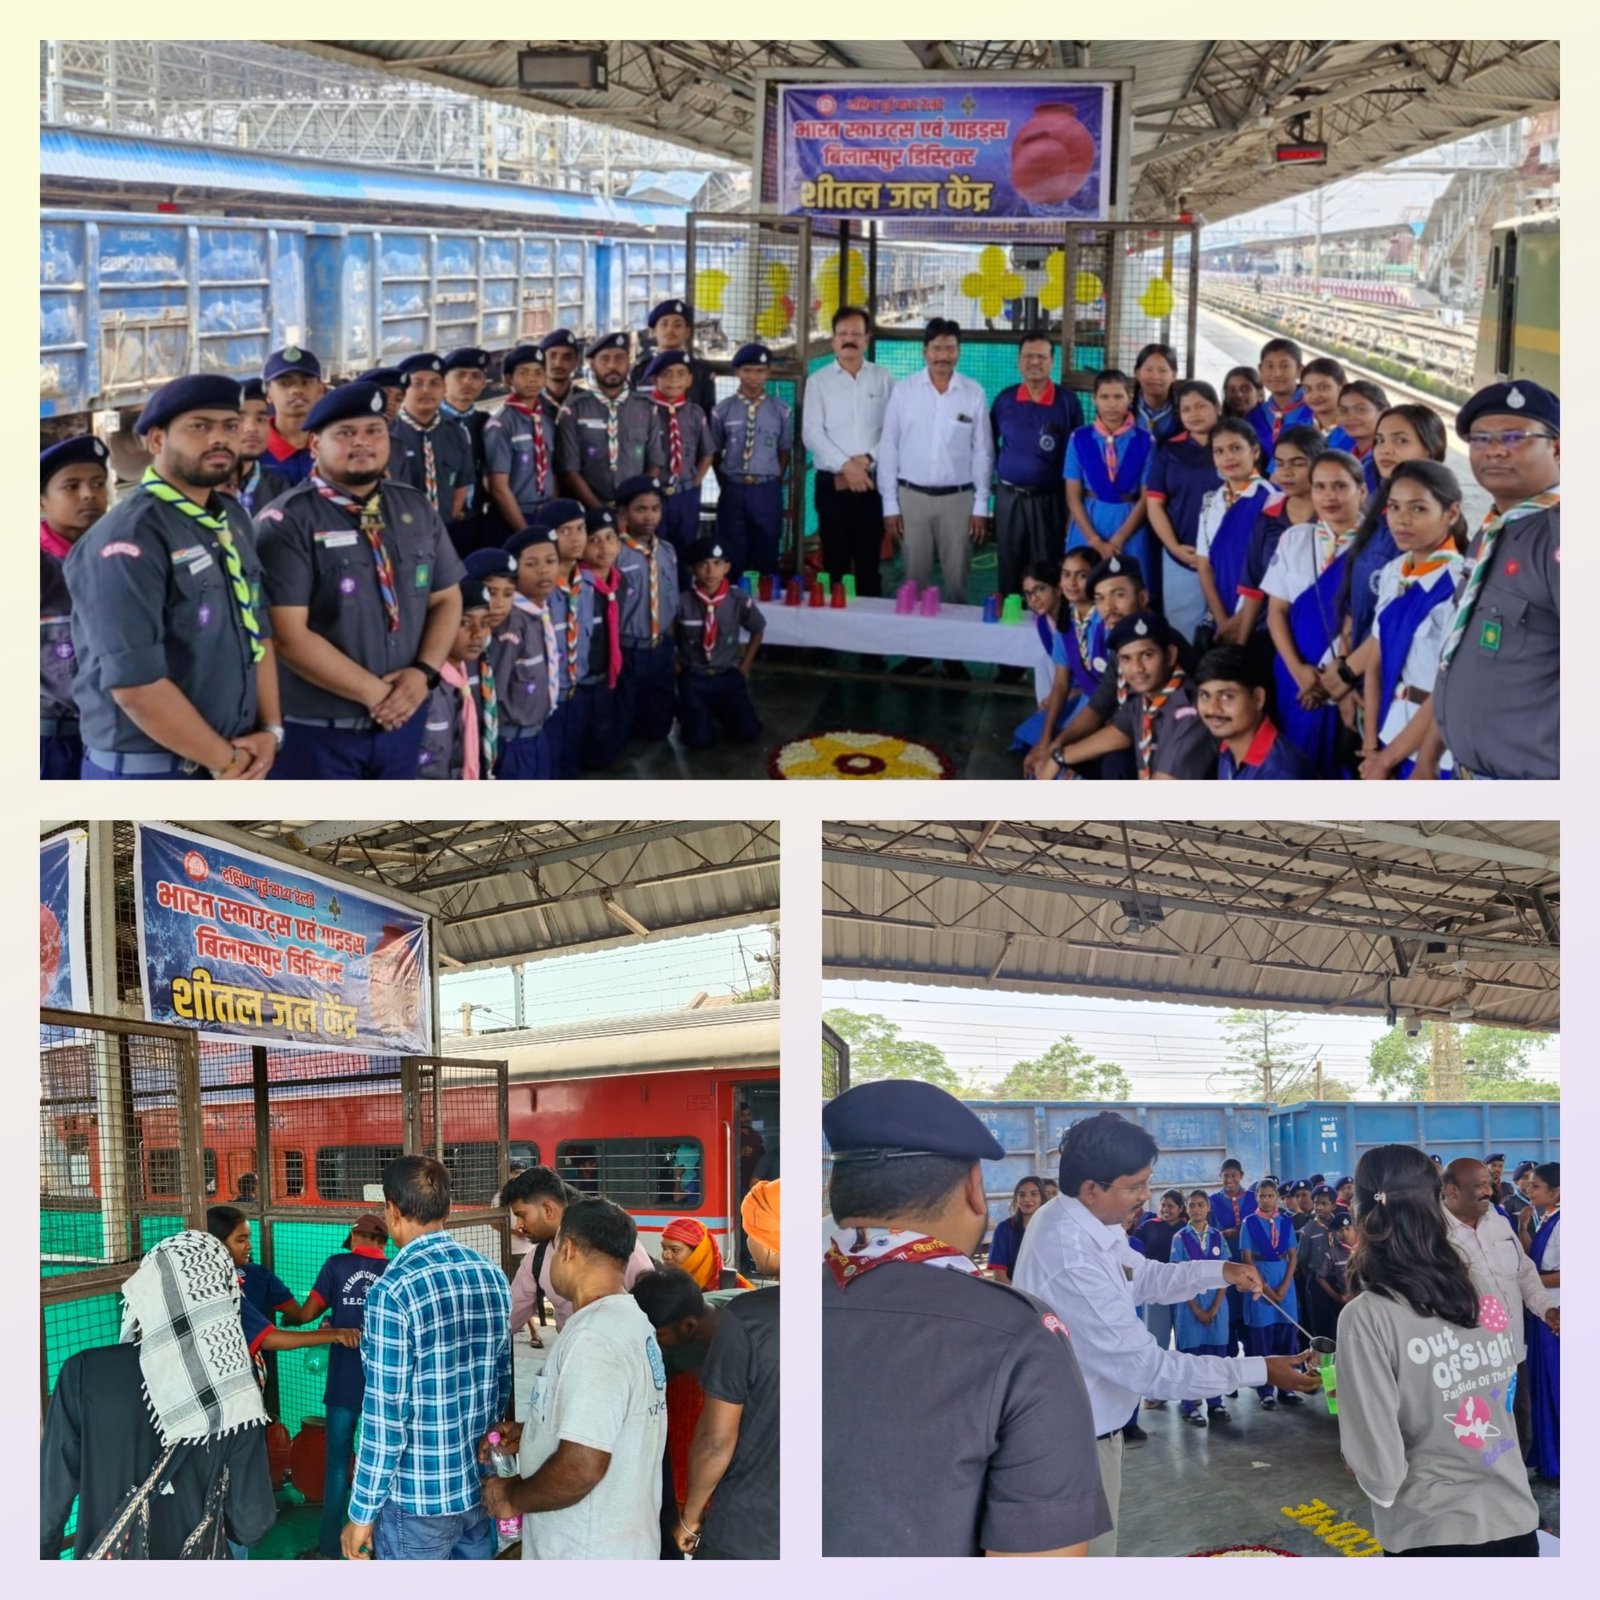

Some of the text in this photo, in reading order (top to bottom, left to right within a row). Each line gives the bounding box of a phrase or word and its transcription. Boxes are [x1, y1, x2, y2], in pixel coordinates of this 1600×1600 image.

[795, 117, 1007, 144] भारत स्काउट्स एवं गाइड्स
[823, 144, 977, 171] बिलासपुर डिस्ट्रिक्ट
[801, 172, 993, 212] शीतल जल केंद्र
[221, 867, 316, 909] दक्षिण पूर्व मध्य रेलवे
[158, 881, 366, 959] भारत स्काउट्स एवं गाइड्स
[195, 926, 345, 984] बिलासपुर डिस्ट्रिक्ट
[172, 967, 359, 1040] शीतल जल केंद्र
[1407, 1326, 1459, 1364] Out
[1458, 1380, 1477, 1394] Side
[1478, 1375, 1490, 1387] Of
[1491, 1371, 1506, 1383] The
